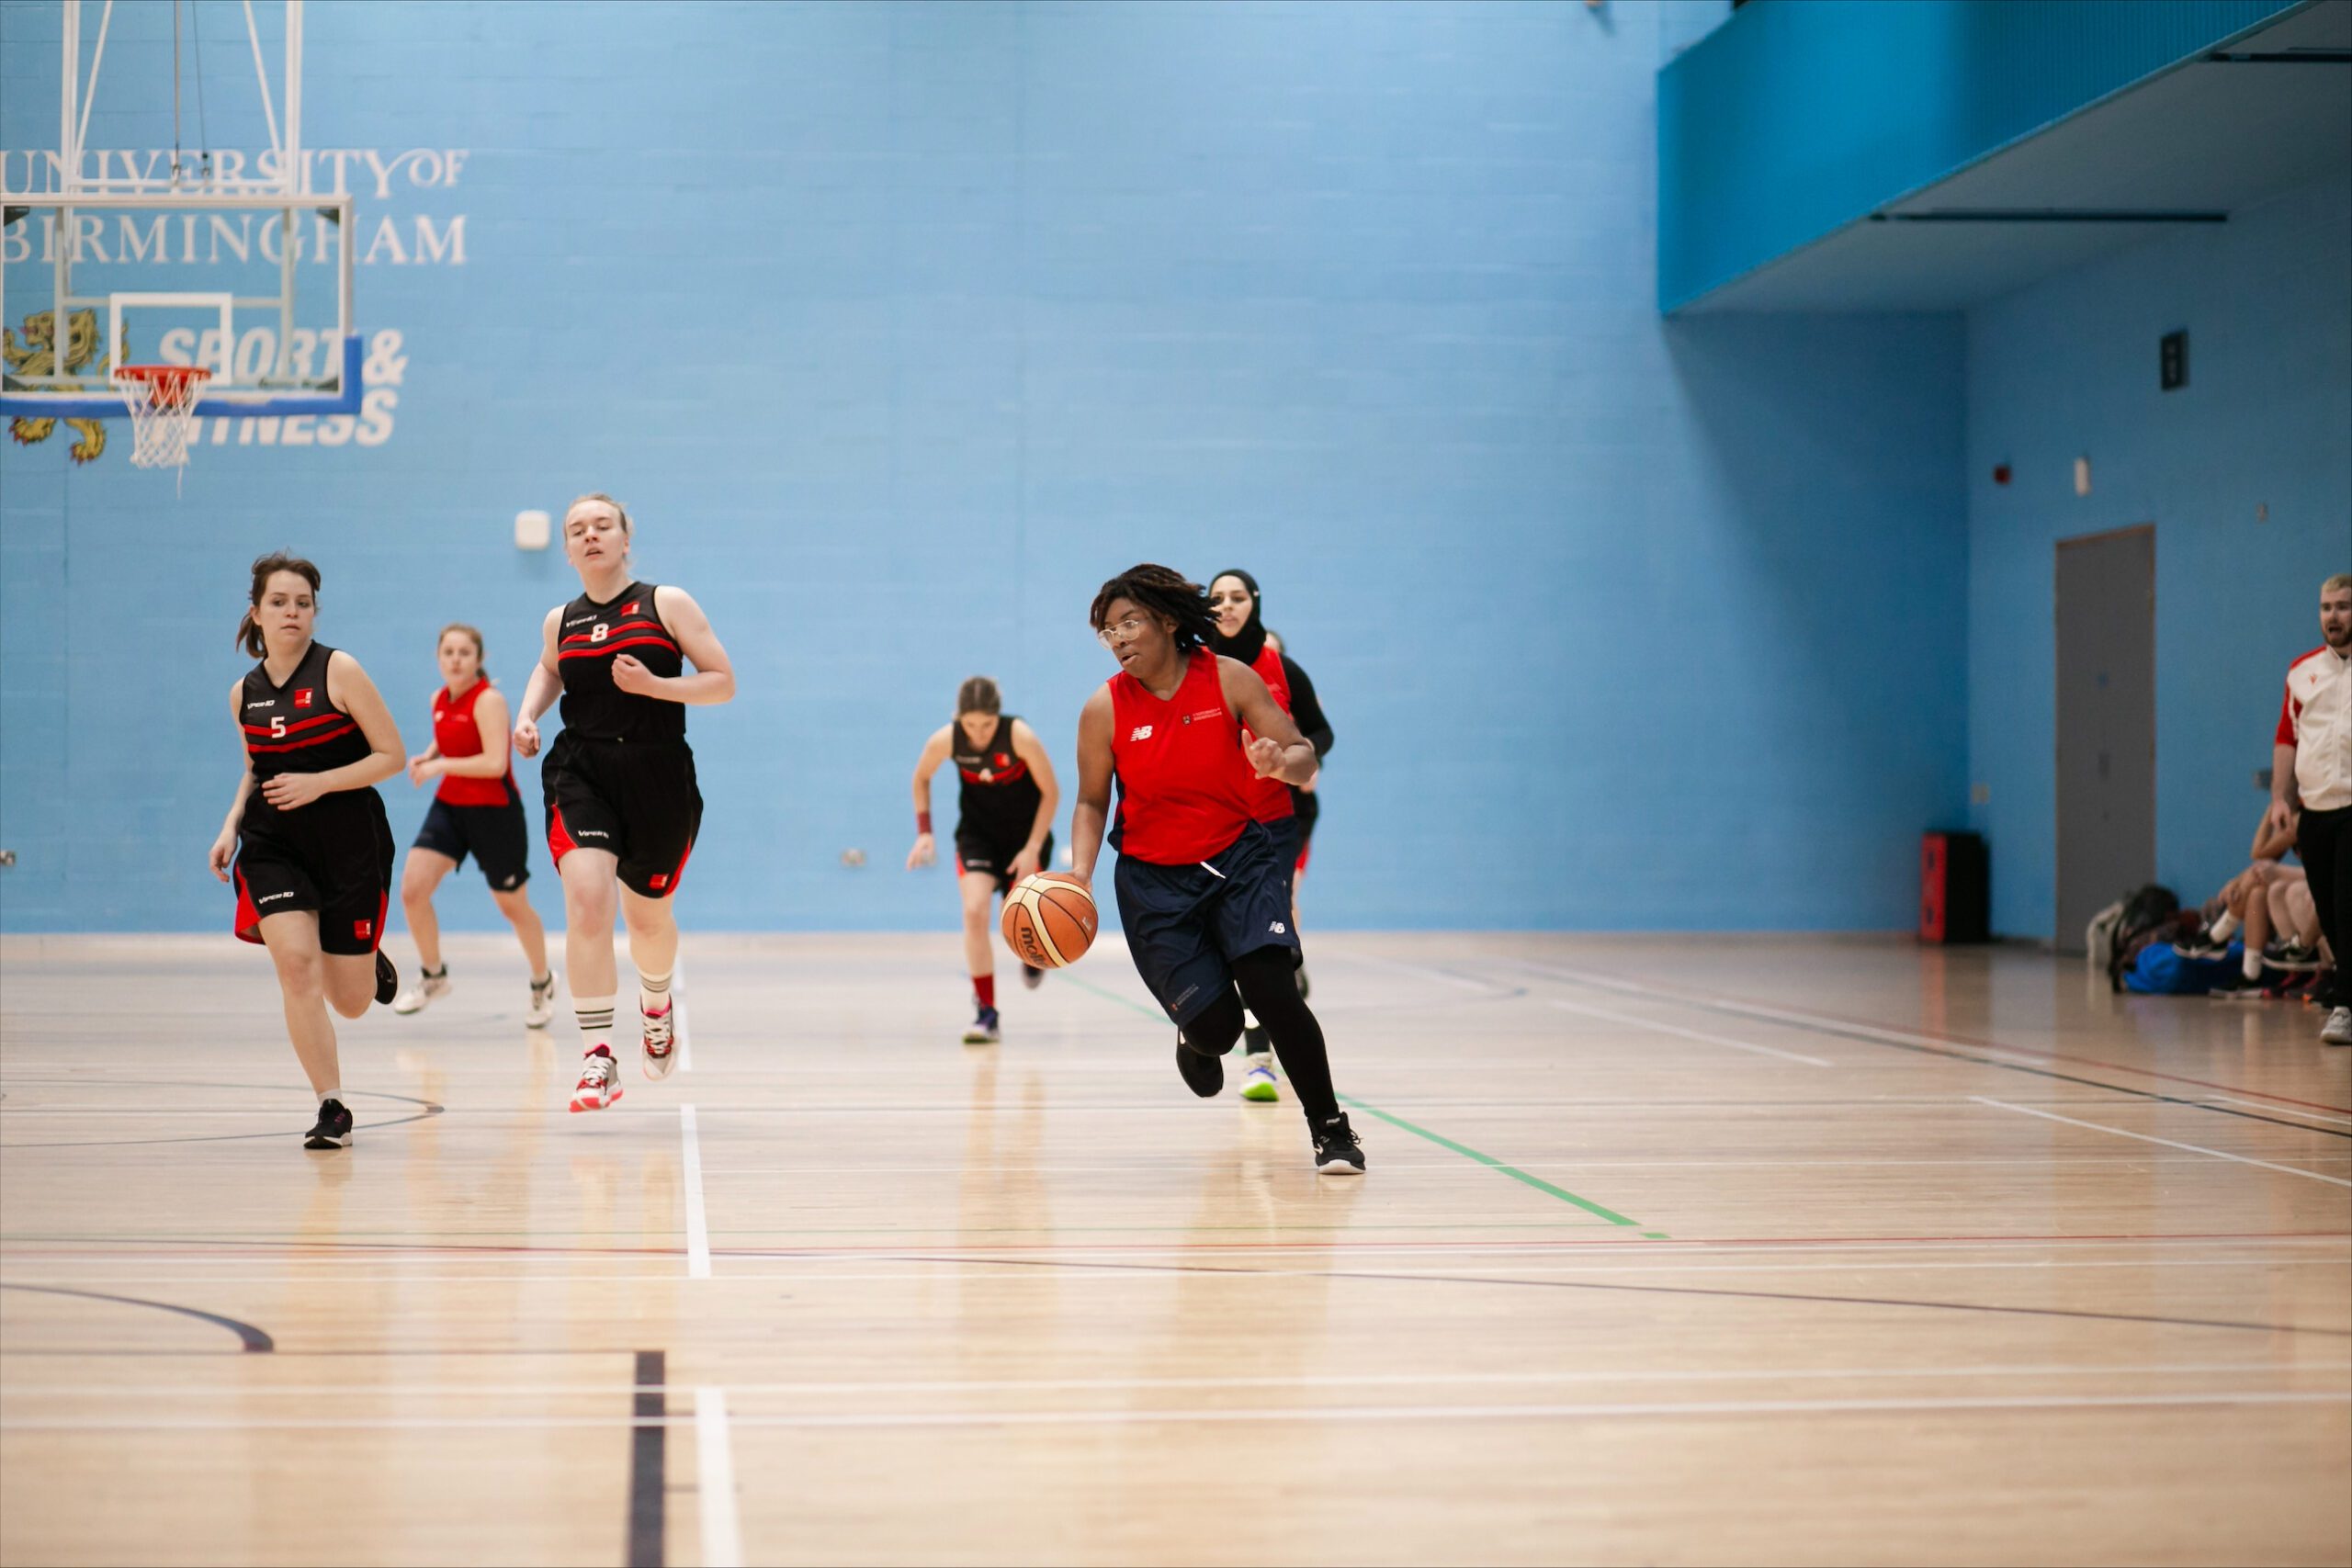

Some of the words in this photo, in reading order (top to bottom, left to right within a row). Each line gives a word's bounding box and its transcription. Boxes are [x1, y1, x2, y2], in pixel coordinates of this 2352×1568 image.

[408, 149, 469, 186] OF
[3, 214, 467, 265] BIRMINGHAM
[362, 329, 409, 386] &
[590, 623, 609, 642] 8
[271, 716, 287, 739] 5
